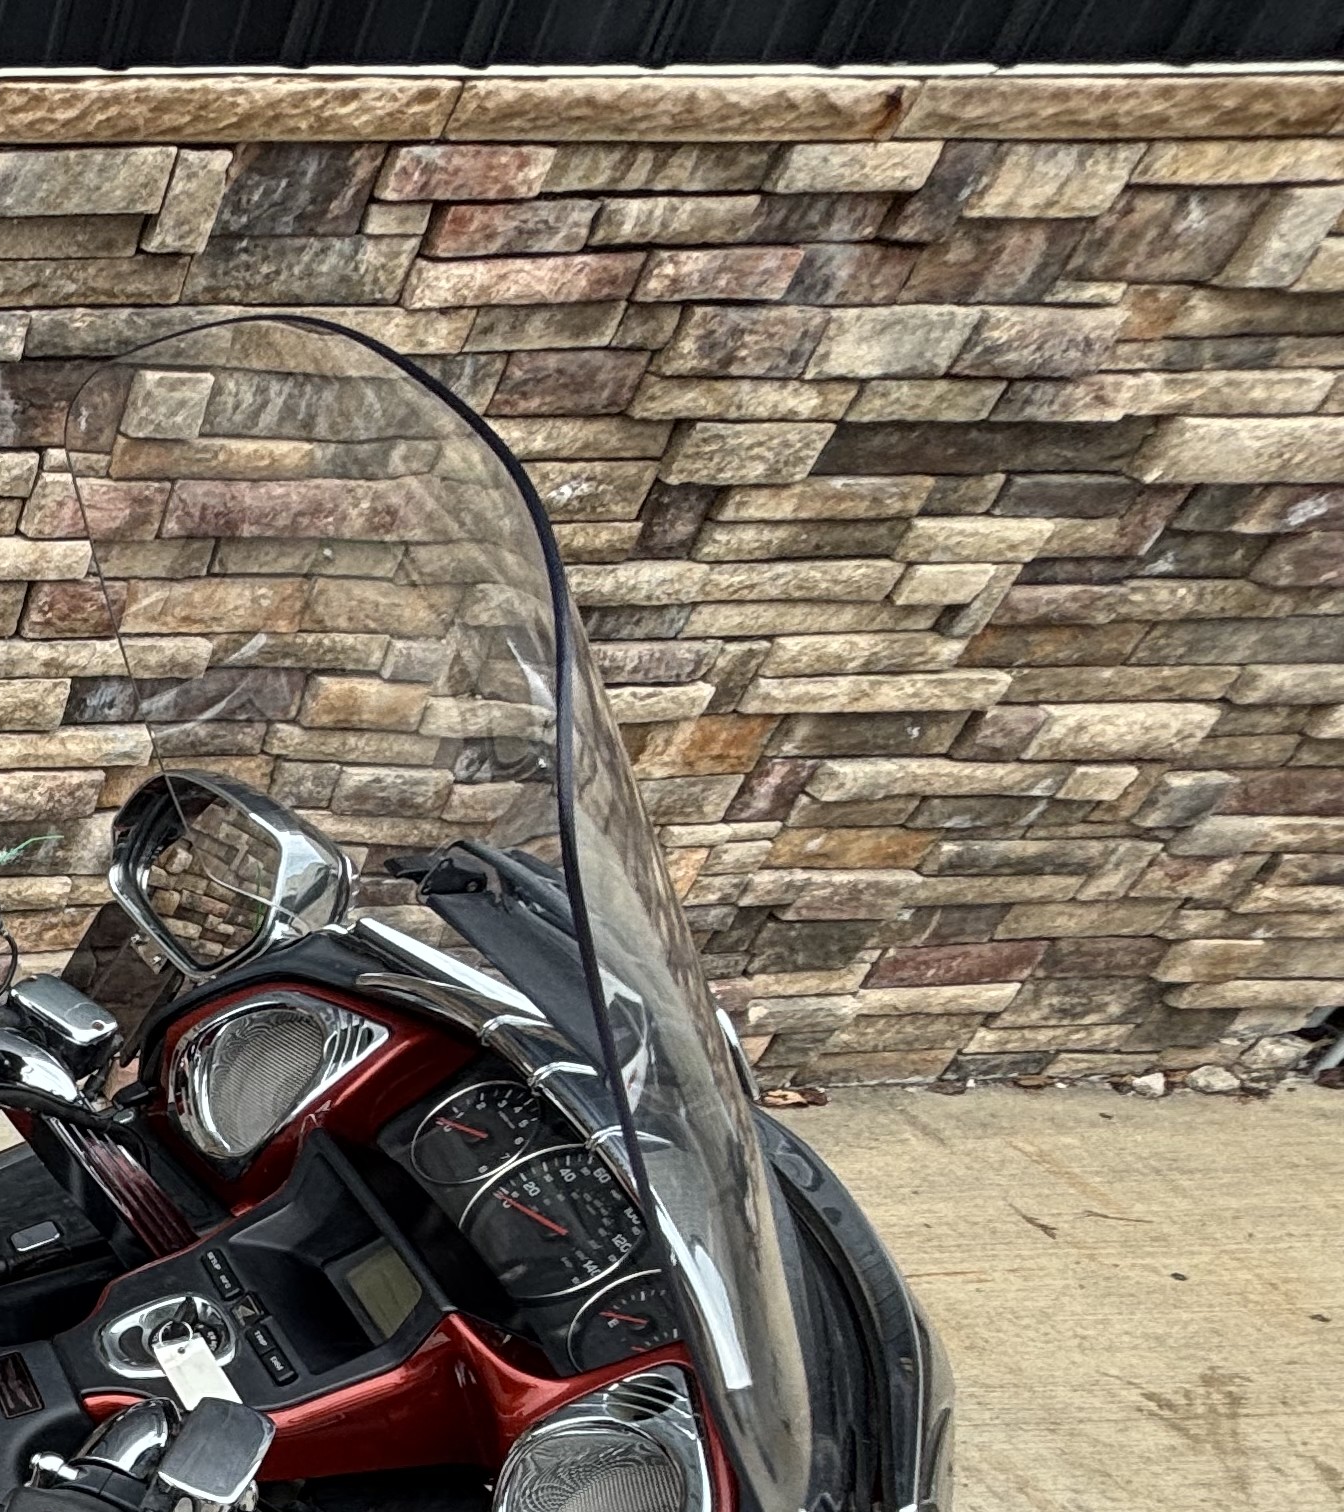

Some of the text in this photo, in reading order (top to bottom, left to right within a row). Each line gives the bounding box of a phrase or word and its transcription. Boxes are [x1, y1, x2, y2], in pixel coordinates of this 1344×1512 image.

[513, 1106, 523, 1114] 4
[559, 1168, 577, 1183] 40
[593, 1168, 612, 1184] 60
[522, 1181, 541, 1197] 20
[611, 1233, 632, 1253] 120
[607, 1318, 619, 1329] E
